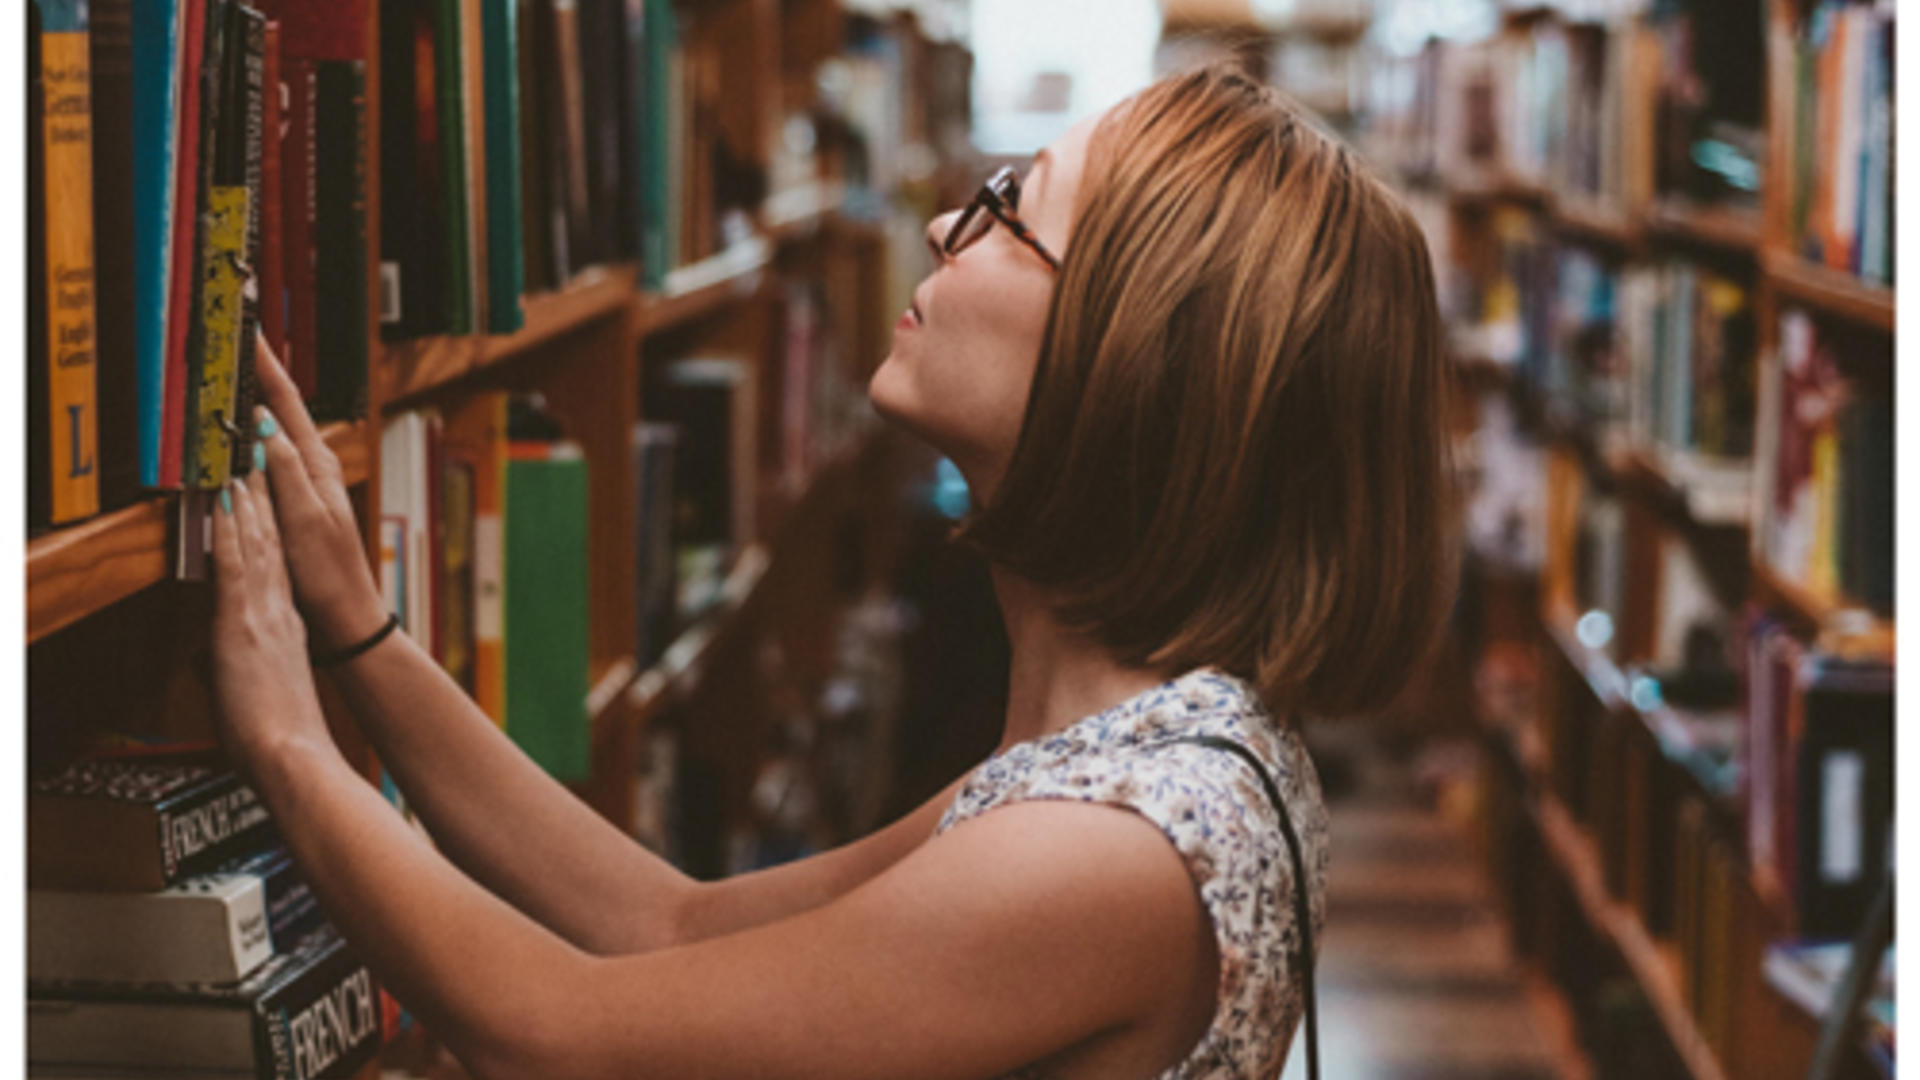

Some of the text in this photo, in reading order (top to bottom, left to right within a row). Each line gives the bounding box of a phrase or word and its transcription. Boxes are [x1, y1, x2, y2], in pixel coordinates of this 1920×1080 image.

[68, 404, 92, 479] L
[172, 794, 232, 861] FRENCH
[290, 965, 376, 1080] FRENCH
